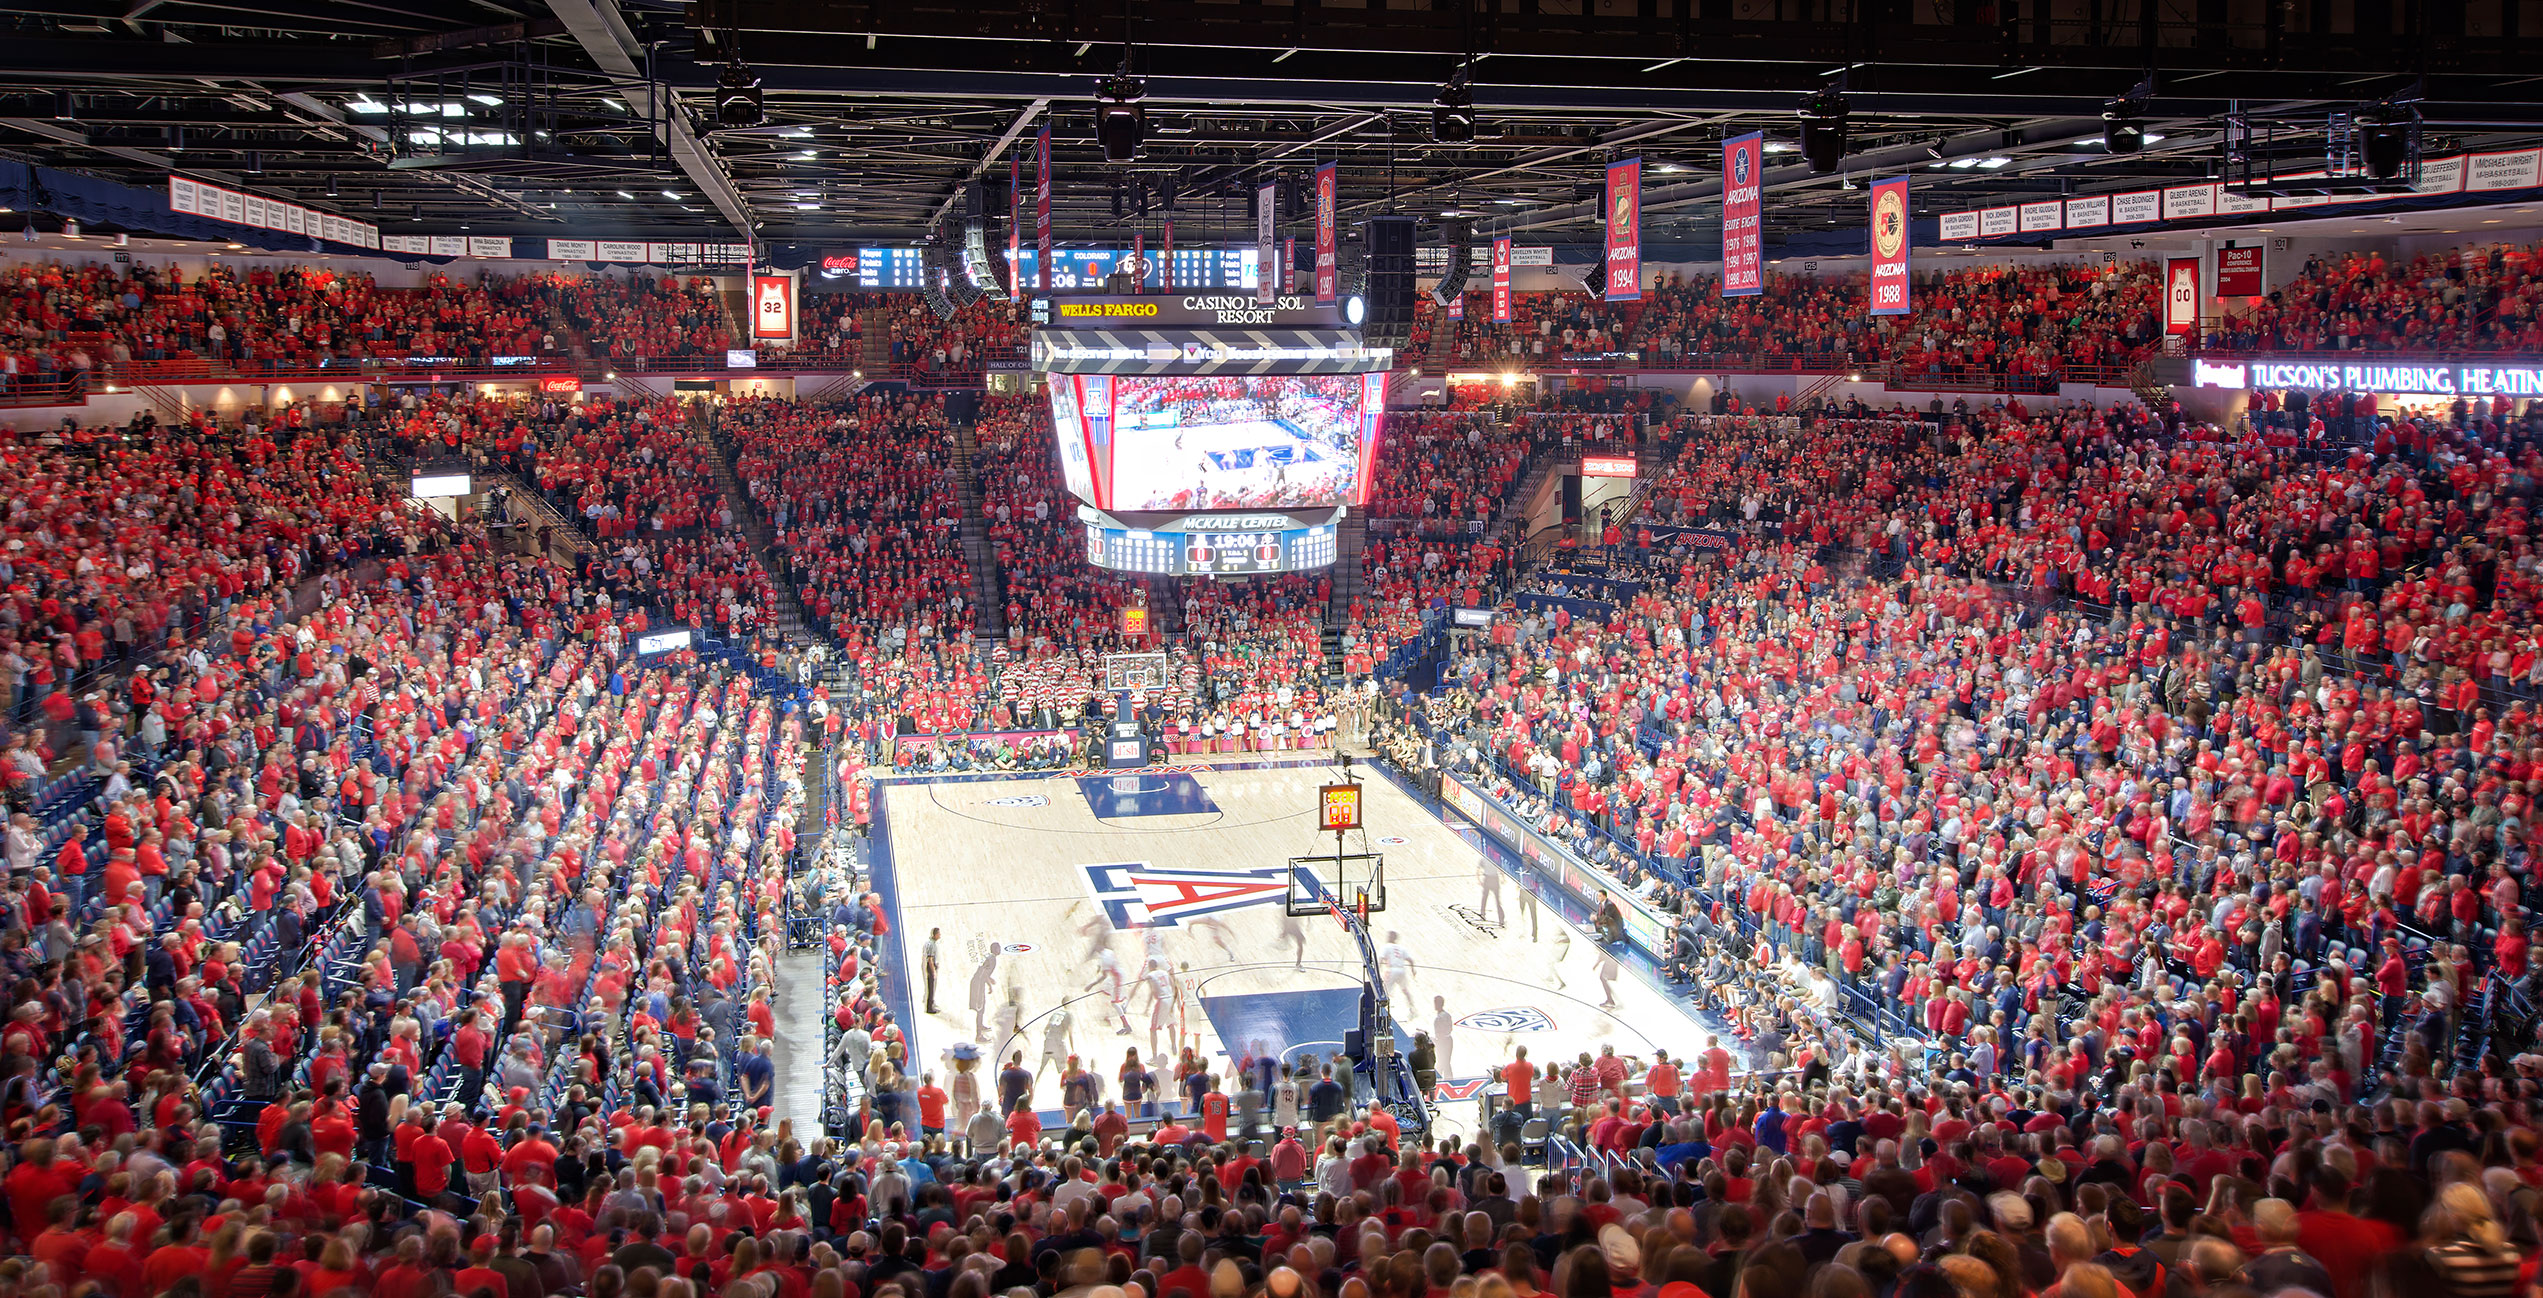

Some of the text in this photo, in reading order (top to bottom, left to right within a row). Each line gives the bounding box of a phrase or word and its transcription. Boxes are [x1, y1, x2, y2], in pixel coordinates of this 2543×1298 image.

[1725, 186, 1758, 206] ARIZONA
[2117, 194, 2156, 205] CHASE BUDINGER
[2170, 188, 2208, 200] GILBERT ARENAS
[2068, 199, 2106, 211] DERRICK WILLIAMS
[2170, 198, 2206, 208] M-BASKETBALL
[1985, 210, 2012, 219] NICK JOHNSON
[2024, 206, 2038, 215] ANDRE
[2077, 209, 2102, 217] BASKETBALL
[1724, 215, 1758, 231] ELITE EIGHT
[1944, 216, 1958, 224] AARON
[1990, 219, 2012, 227] BASKETBALL
[2032, 214, 2056, 222] BASKETBALL
[602, 243, 626, 251] CAROLINE
[2274, 239, 2285, 248] 101
[1073, 252, 1110, 260] COLORADO
[1316, 253, 1335, 268] ARIZONA
[1608, 246, 1636, 261] ARIZONA
[2227, 250, 2252, 260] Pac-10
[1088, 261, 1098, 276] 0
[1726, 256, 1740, 268] 1994
[1875, 263, 1906, 277] ARIZONA
[1032, 273, 1077, 288] 1:06
[1613, 269, 1634, 288] 1994
[1726, 270, 1757, 285] 1998 2001
[1319, 276, 1333, 296] 1997
[1878, 284, 1901, 303] 1988
[2175, 289, 2191, 302] 00
[764, 302, 782, 313] 32
[1059, 303, 1158, 317] WELLS FARGO
[1183, 296, 1305, 311] CASINO SOL
[1217, 310, 1275, 324] RESORT
[2252, 364, 2341, 390] TUCSON'S
[2345, 366, 2456, 394] PLUMBING,
[2462, 369, 2543, 395] HEATIN
[1183, 516, 1289, 530] MCKALE CENTER
[1214, 535, 1257, 548] 19:06
[1674, 532, 1727, 548] ARIZONA
[1196, 547, 1206, 562] 0
[1263, 546, 1273, 560] 0
[1127, 619, 1142, 632] 23
[1114, 744, 1138, 757] dish
[1050, 765, 1215, 778] ARIZONA
[1501, 823, 1516, 843] zero
[1539, 850, 1556, 872] zero
[1565, 866, 1600, 905] Coke zero
[1185, 978, 1195, 991] 21
[1210, 1101, 1222, 1115] 15
